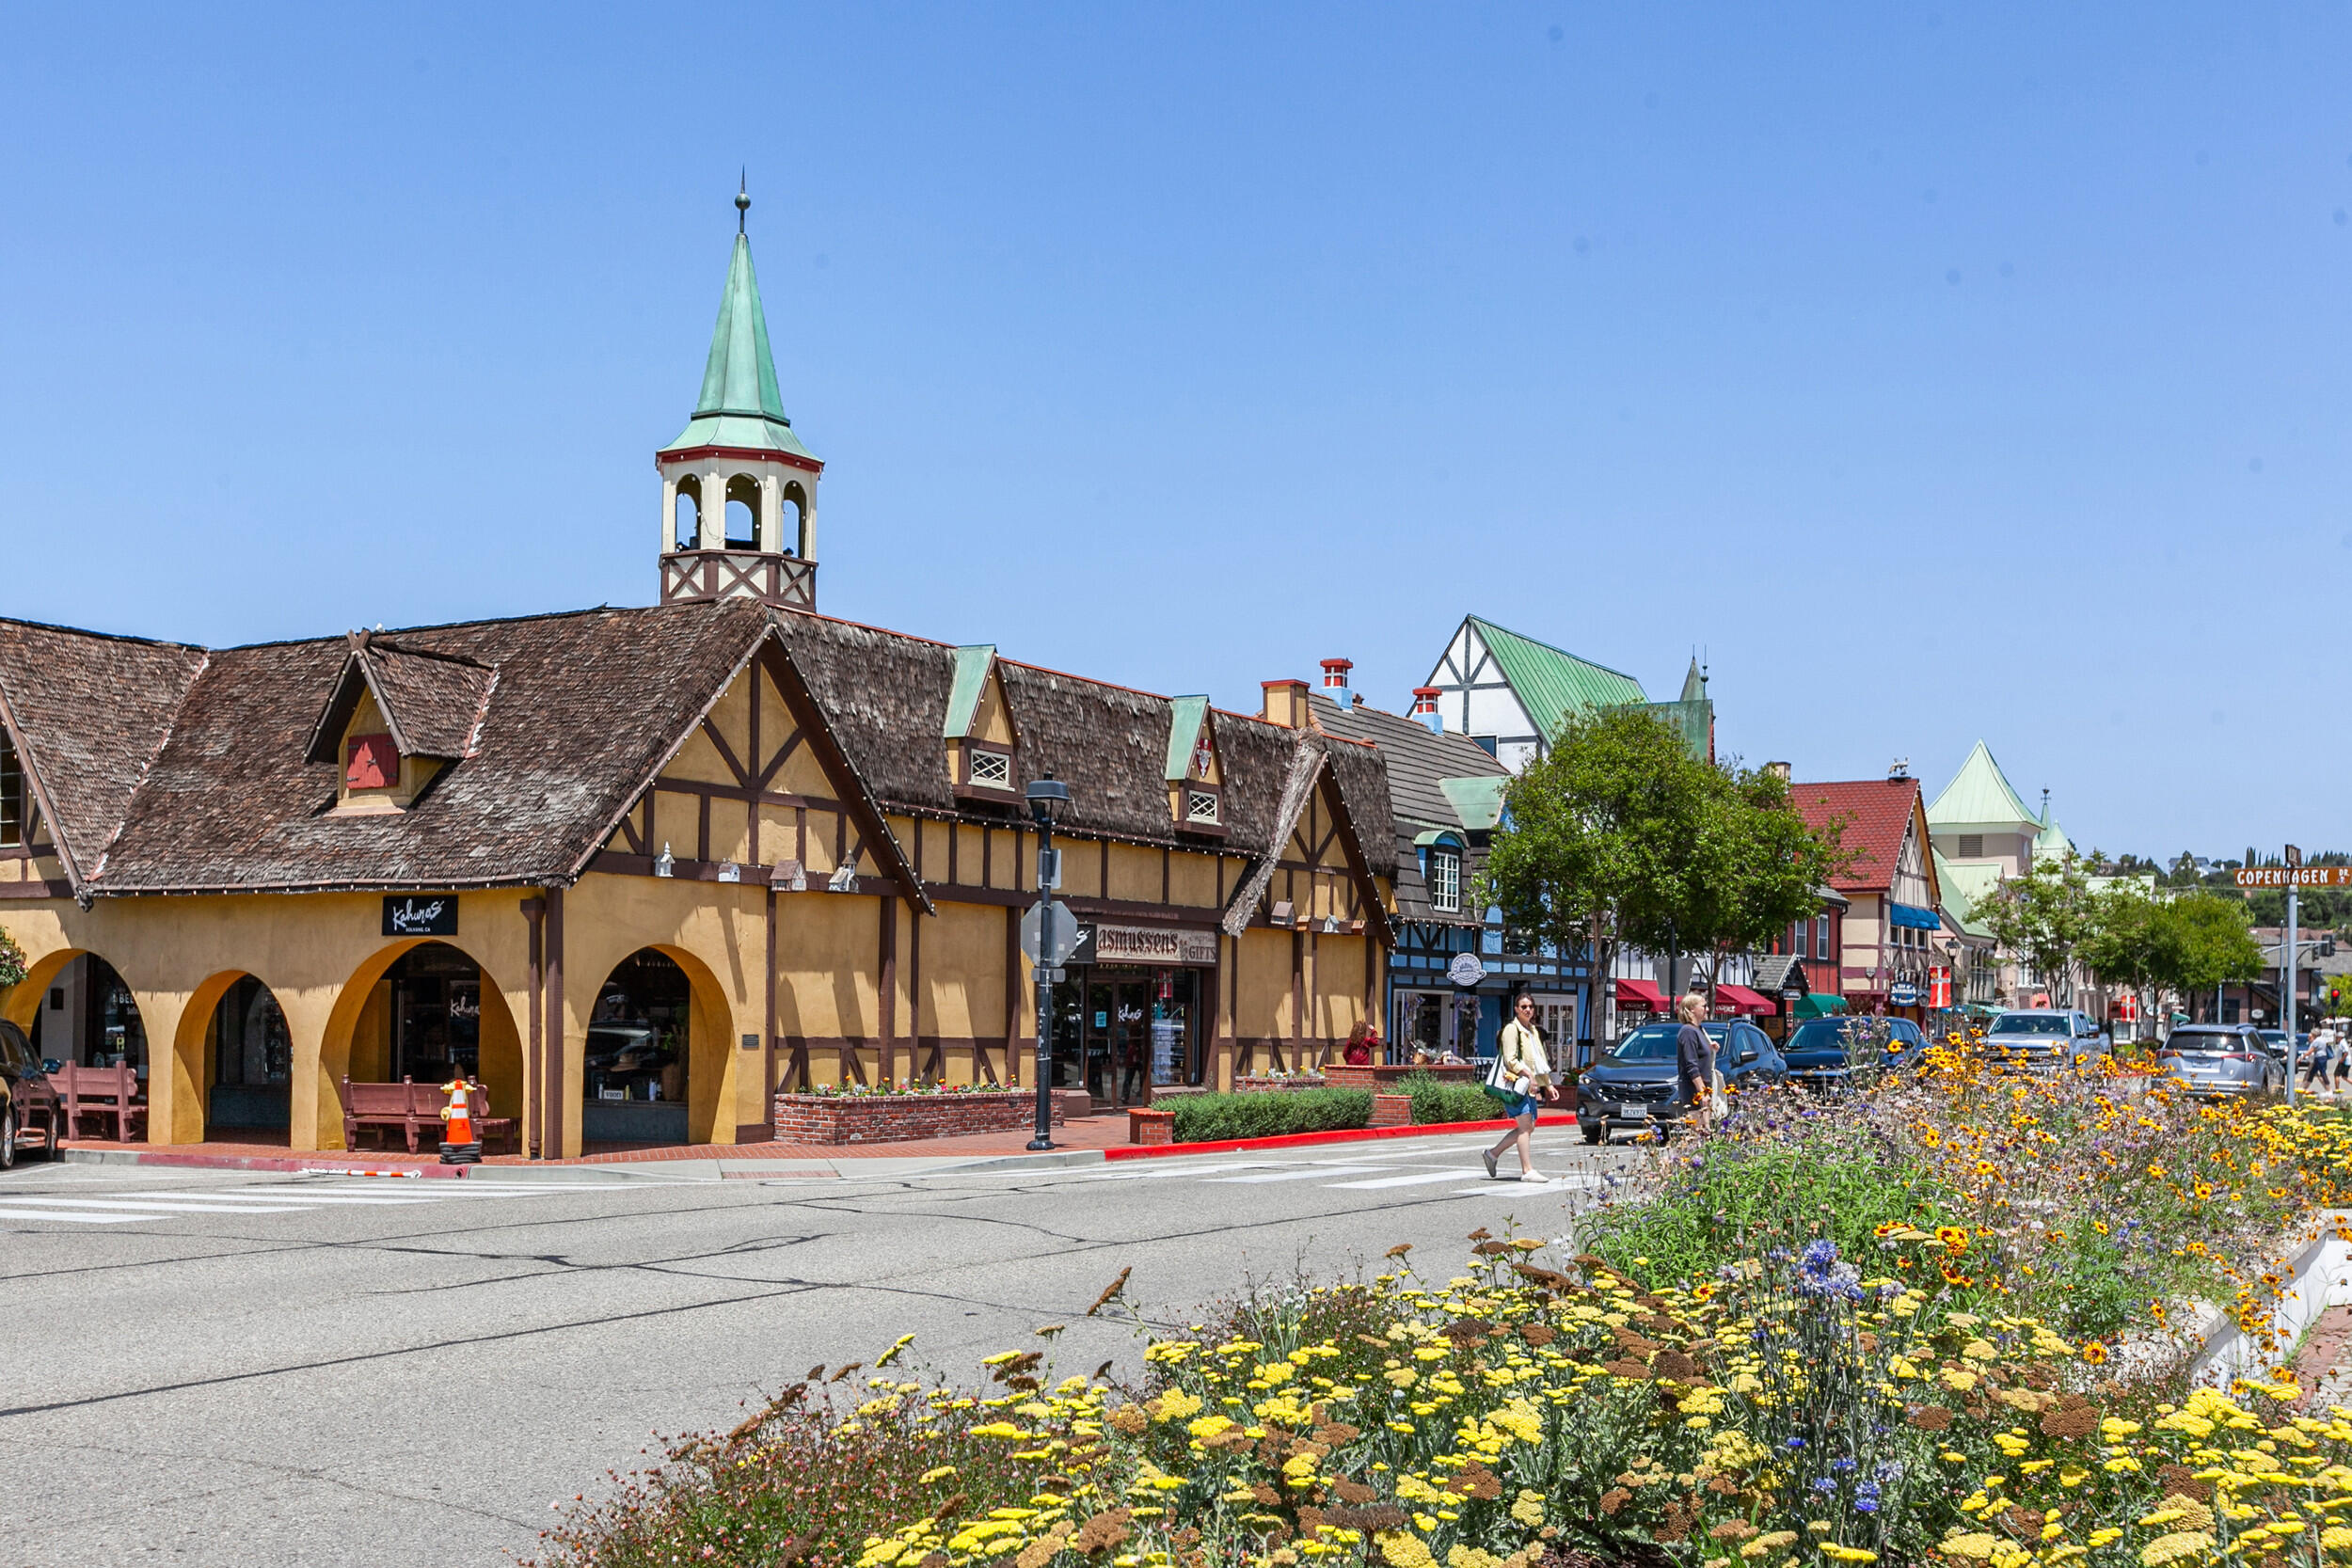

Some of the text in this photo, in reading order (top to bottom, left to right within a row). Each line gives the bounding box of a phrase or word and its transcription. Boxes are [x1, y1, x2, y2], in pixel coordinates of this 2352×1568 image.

[2237, 868, 2350, 885] COPENHAGEN DR.
[1188, 945, 1216, 959] GIFTS
[1891, 986, 1916, 994] Denmark
[451, 995, 481, 1017] Kahuna
